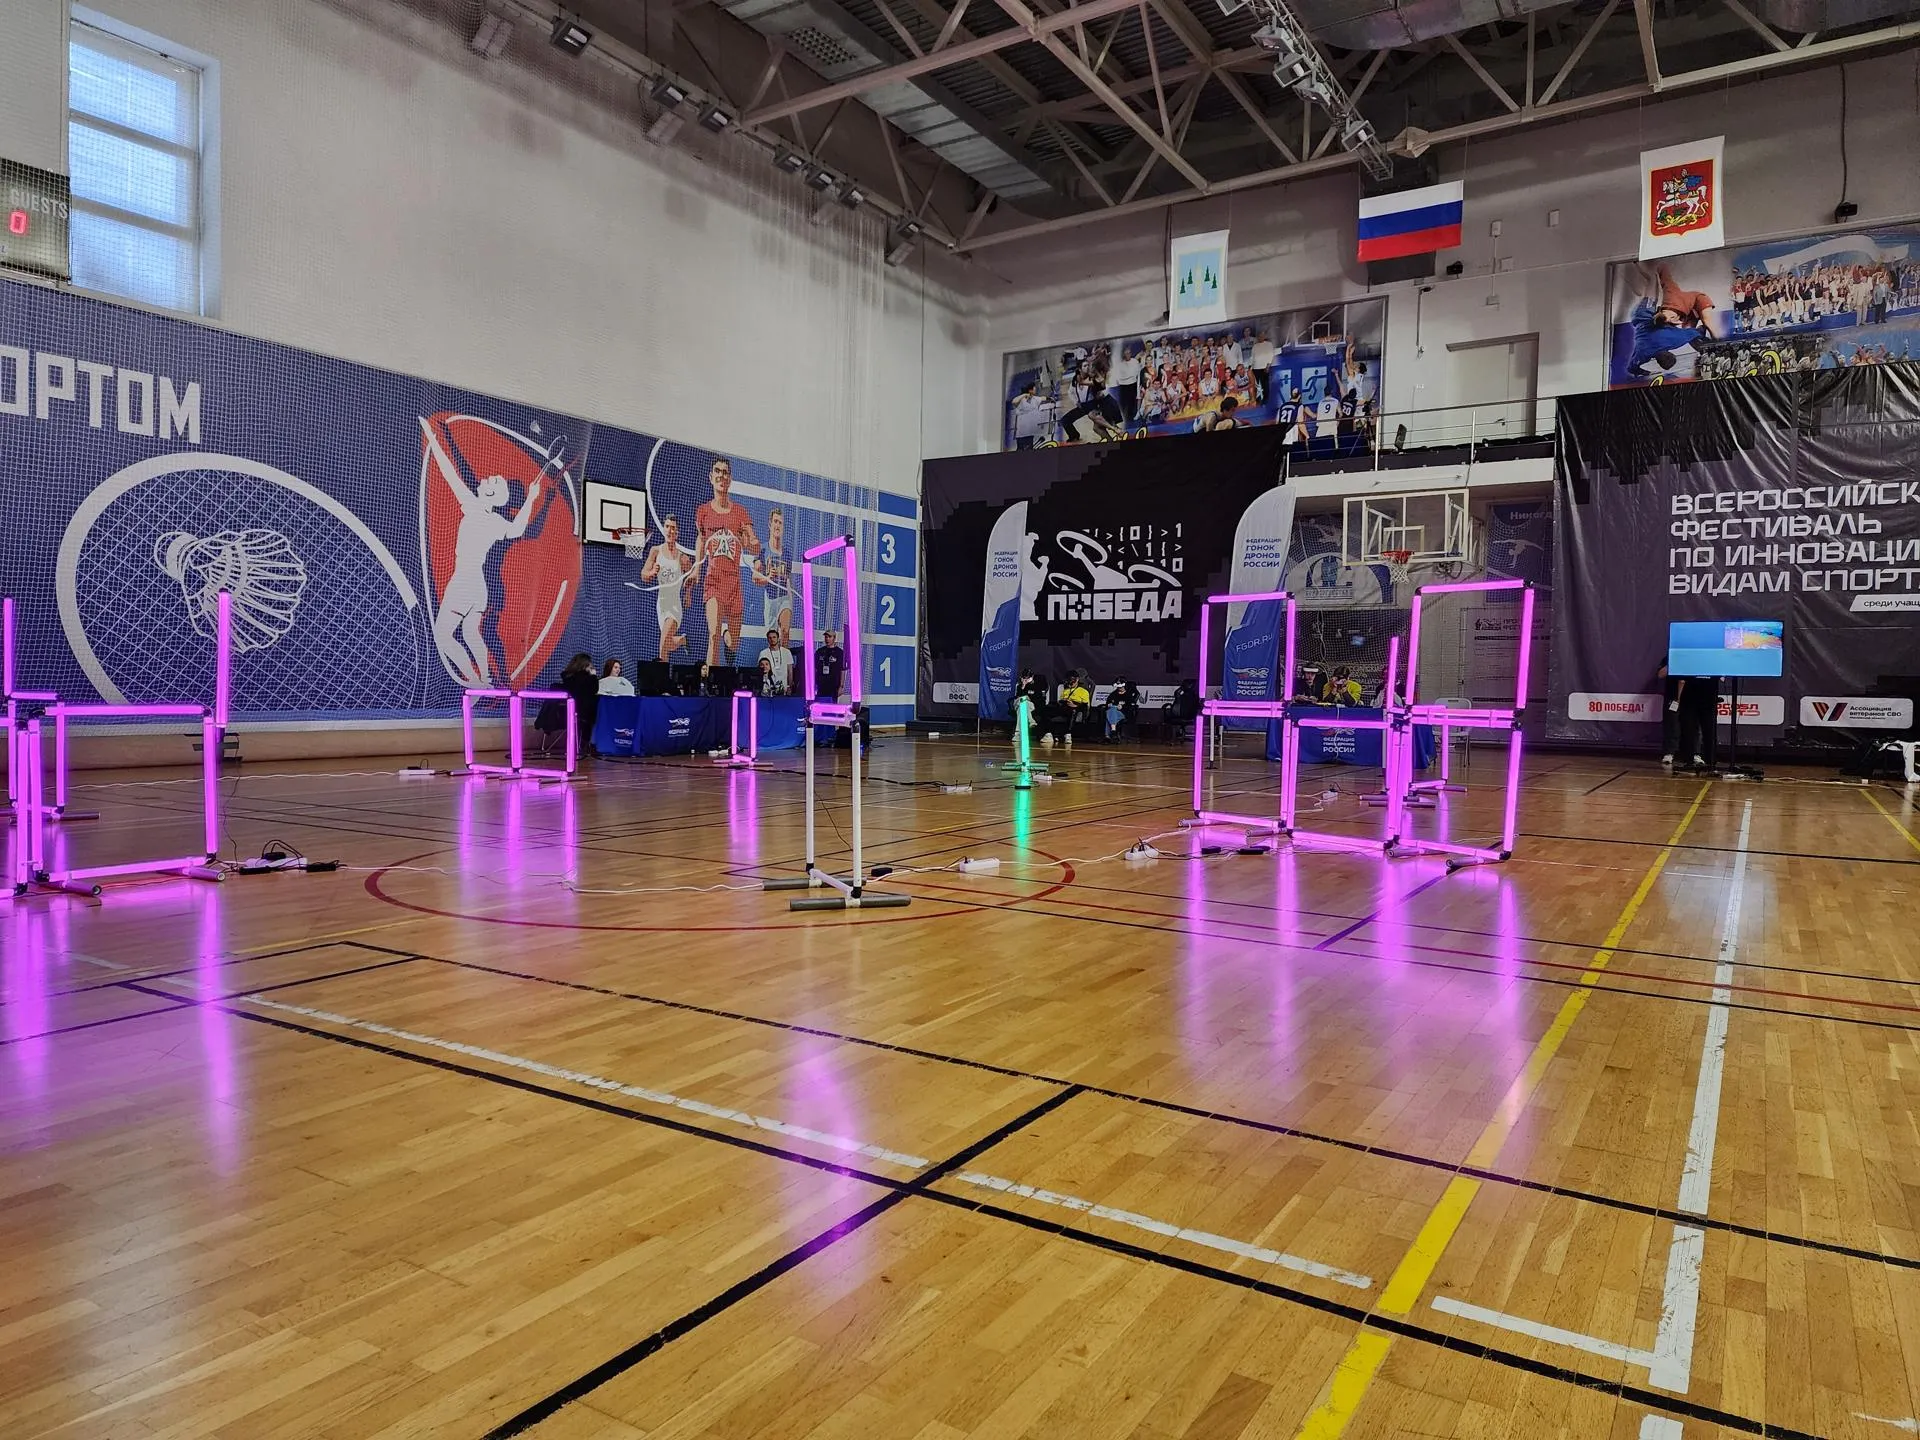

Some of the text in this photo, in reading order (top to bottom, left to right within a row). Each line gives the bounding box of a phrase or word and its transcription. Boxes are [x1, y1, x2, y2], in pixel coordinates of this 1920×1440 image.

[10, 187, 69, 220] GUESTS
[1280, 409, 1293, 423] 21
[1324, 403, 1331, 414] 9
[1671, 479, 1920, 515] ВСЕРОССИЙСК
[1670, 512, 1882, 541] ФЕСТИВАЛЬ
[881, 533, 896, 564] 3
[1669, 539, 1920, 568] ПО ИННОВАЦИ
[1669, 567, 1920, 597] ВИДАМ СПОРТ
[880, 595, 896, 626] 2
[1863, 600, 1893, 608] среди
[880, 657, 891, 687] 1
[1589, 701, 1645, 713] 80 ПОБЕДА!
